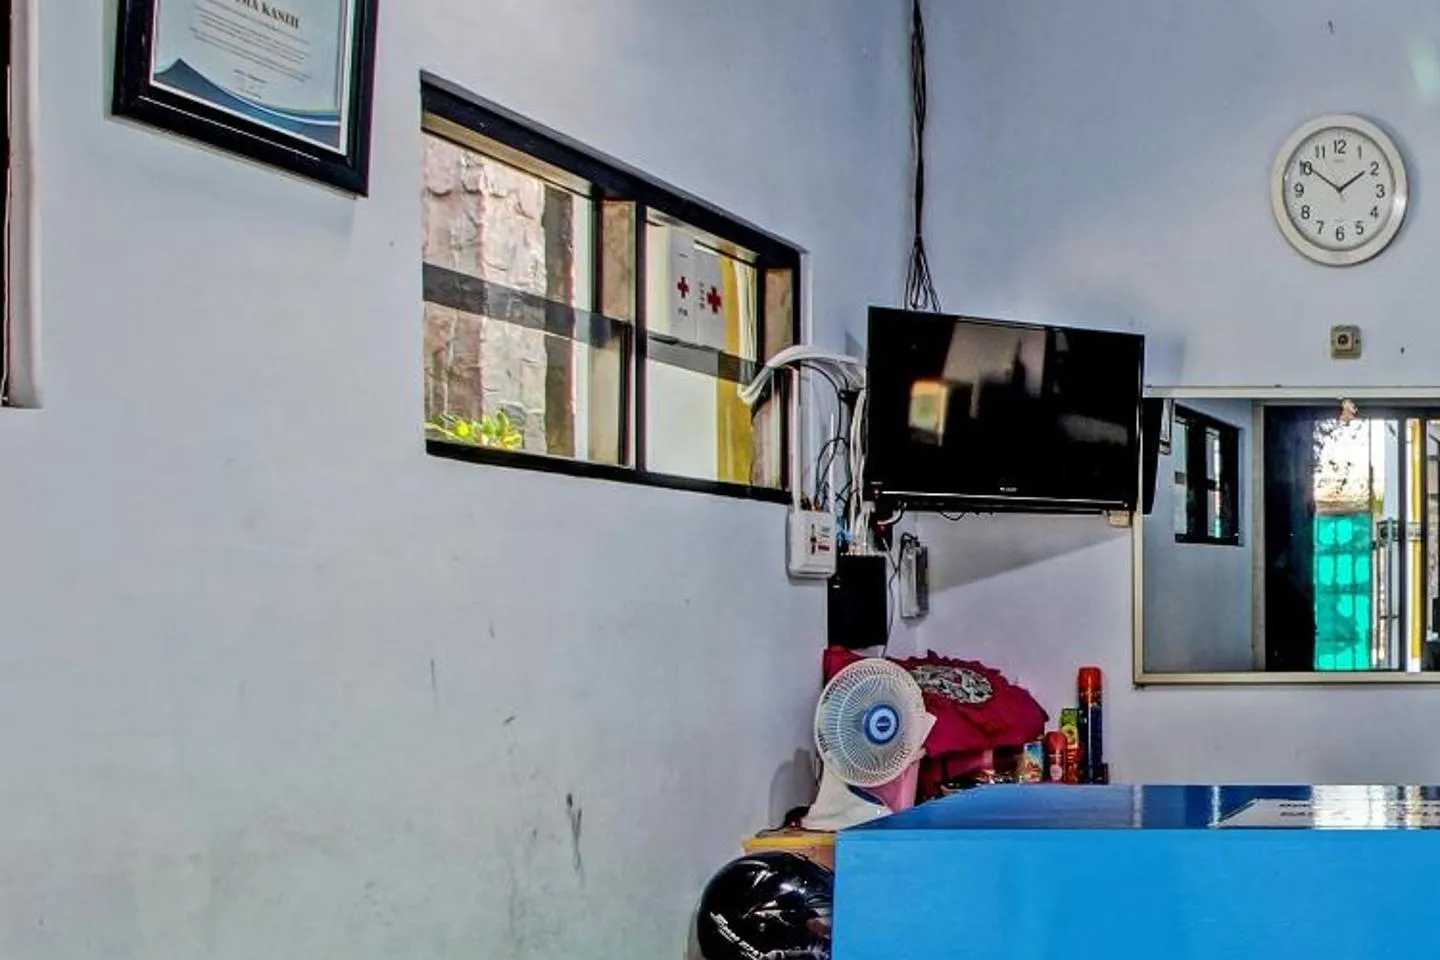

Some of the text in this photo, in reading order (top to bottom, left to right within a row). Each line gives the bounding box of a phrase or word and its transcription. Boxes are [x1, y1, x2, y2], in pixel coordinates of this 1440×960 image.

[1315, 145, 1326, 159] 11
[1333, 139, 1347, 154] 12
[1356, 144, 1362, 159] 1
[1370, 161, 1380, 176] 2
[1293, 183, 1304, 198] 9
[1375, 184, 1386, 199] 3
[1301, 204, 1311, 219] 8
[1369, 206, 1379, 219] 4
[1316, 220, 1325, 235] 7
[1335, 226, 1345, 241] 6
[1355, 220, 1364, 235] 5
